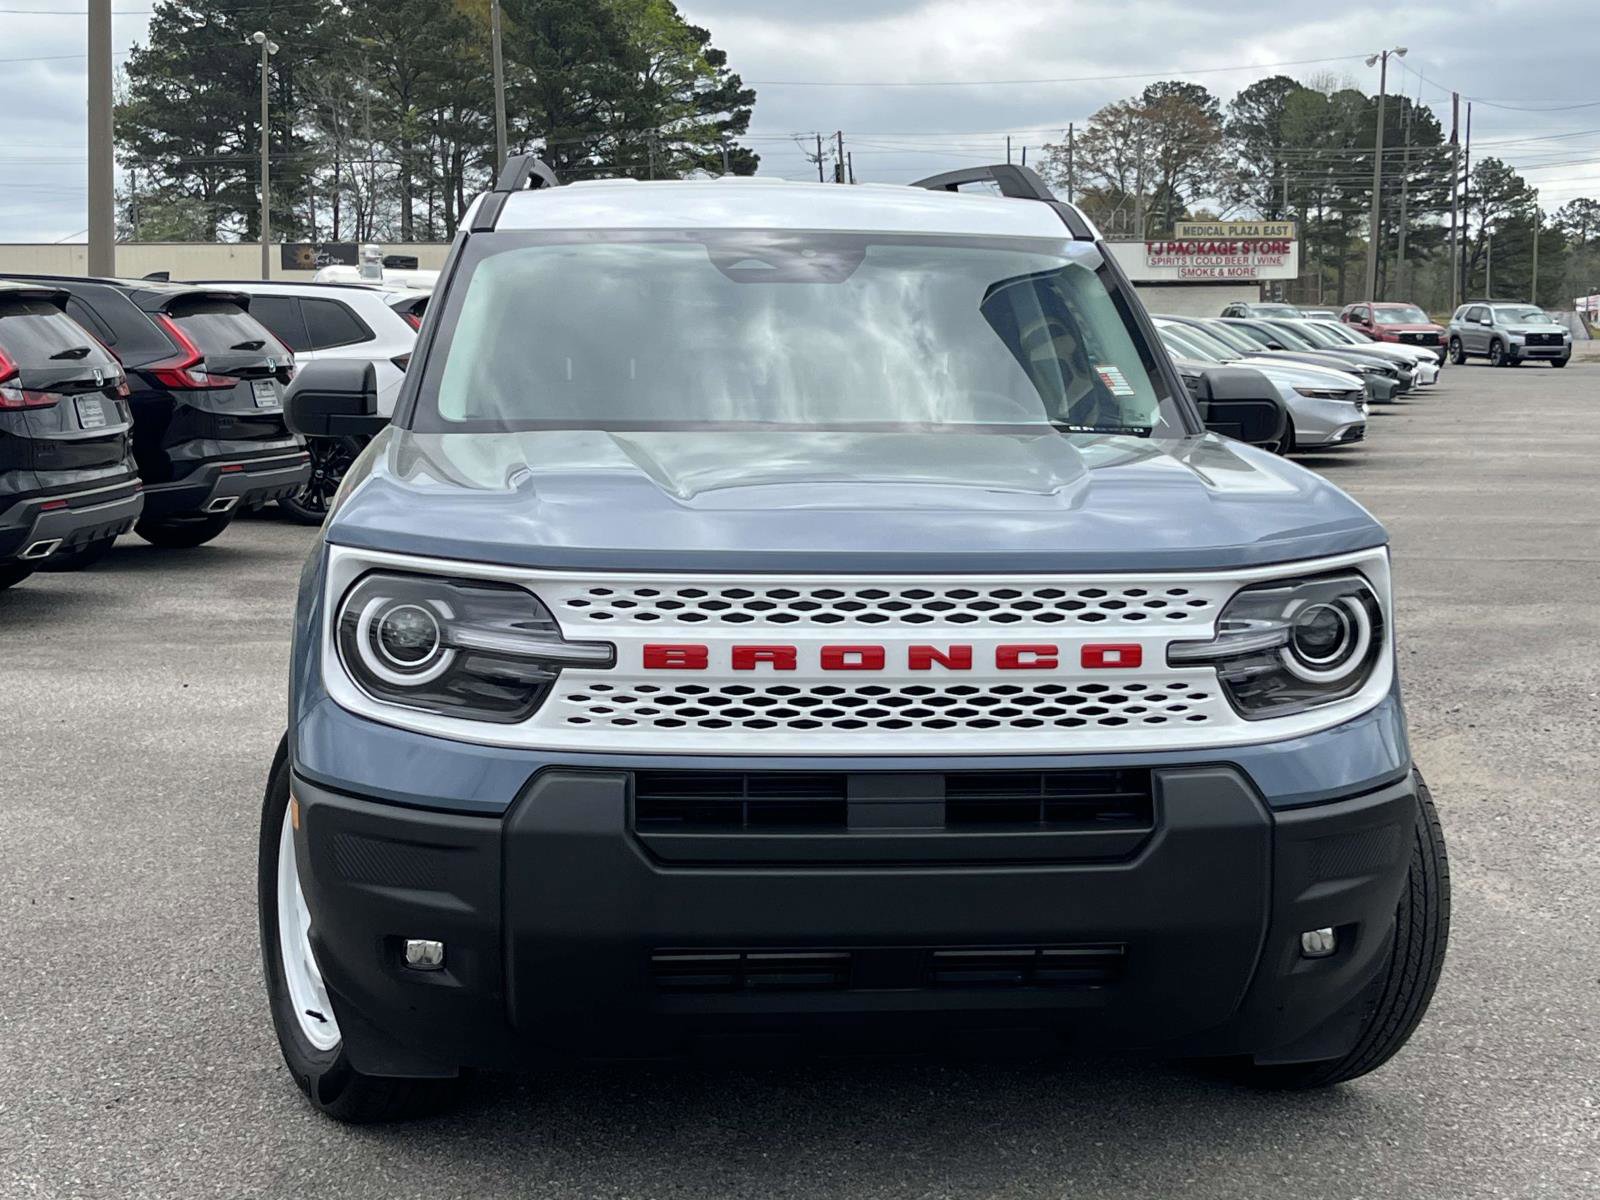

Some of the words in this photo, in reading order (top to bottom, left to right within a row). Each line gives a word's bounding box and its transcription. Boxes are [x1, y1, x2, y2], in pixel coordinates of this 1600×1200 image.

[1183, 226, 1224, 237] MEDICAL
[1228, 226, 1259, 236] PLAZA
[1264, 225, 1289, 236] EAST
[1145, 241, 1164, 255] TJ
[1166, 240, 1238, 256] PACKAGE
[1241, 240, 1291, 255] STORE
[1150, 257, 1187, 265] SPIRITS
[1195, 257, 1224, 265] COLD
[1224, 256, 1249, 265] BEER
[1257, 256, 1282, 264] WINE
[1180, 268, 1215, 277] SMOKE
[1217, 268, 1224, 277] &
[1227, 268, 1256, 277] MORE
[643, 643, 1143, 671] BRONCO
